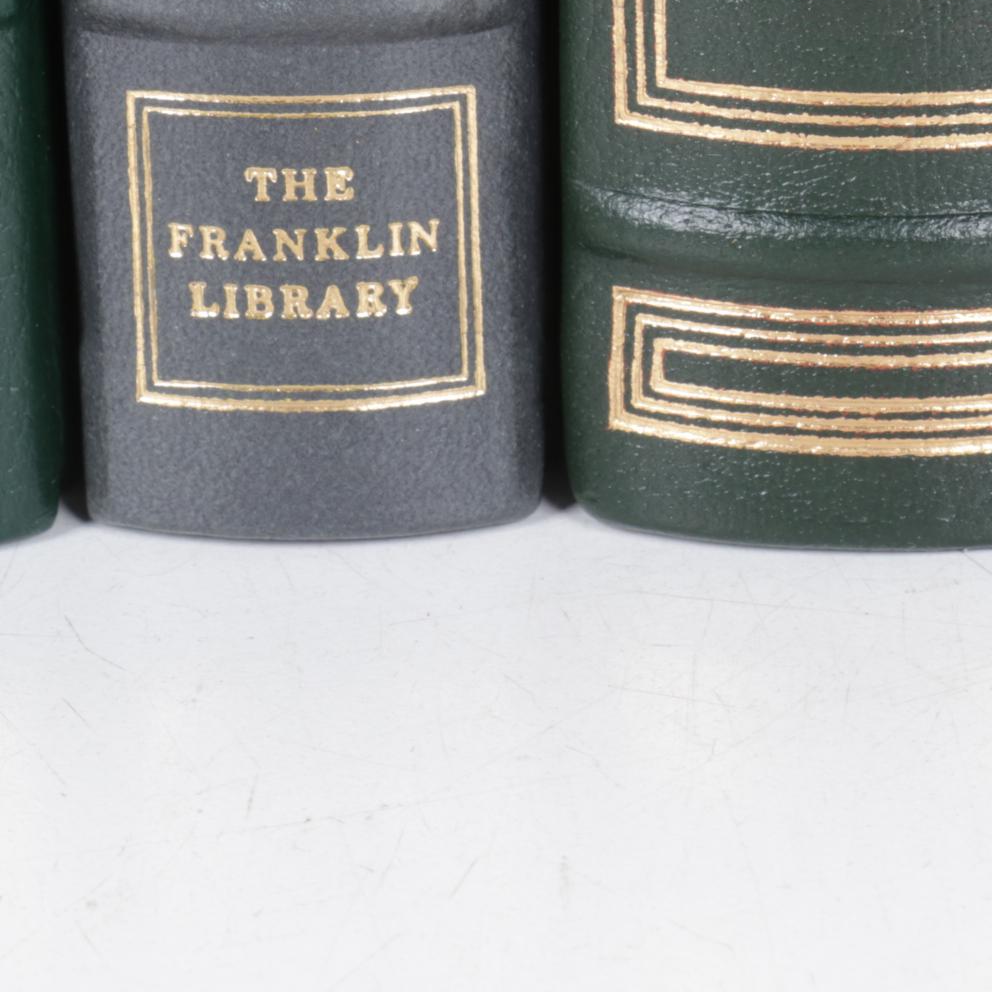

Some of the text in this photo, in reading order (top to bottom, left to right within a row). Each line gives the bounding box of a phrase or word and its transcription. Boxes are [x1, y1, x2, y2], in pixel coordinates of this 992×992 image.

[244, 167, 354, 202] THE
[169, 220, 439, 261] FRANKLIN
[189, 277, 418, 319] LIBRARY
